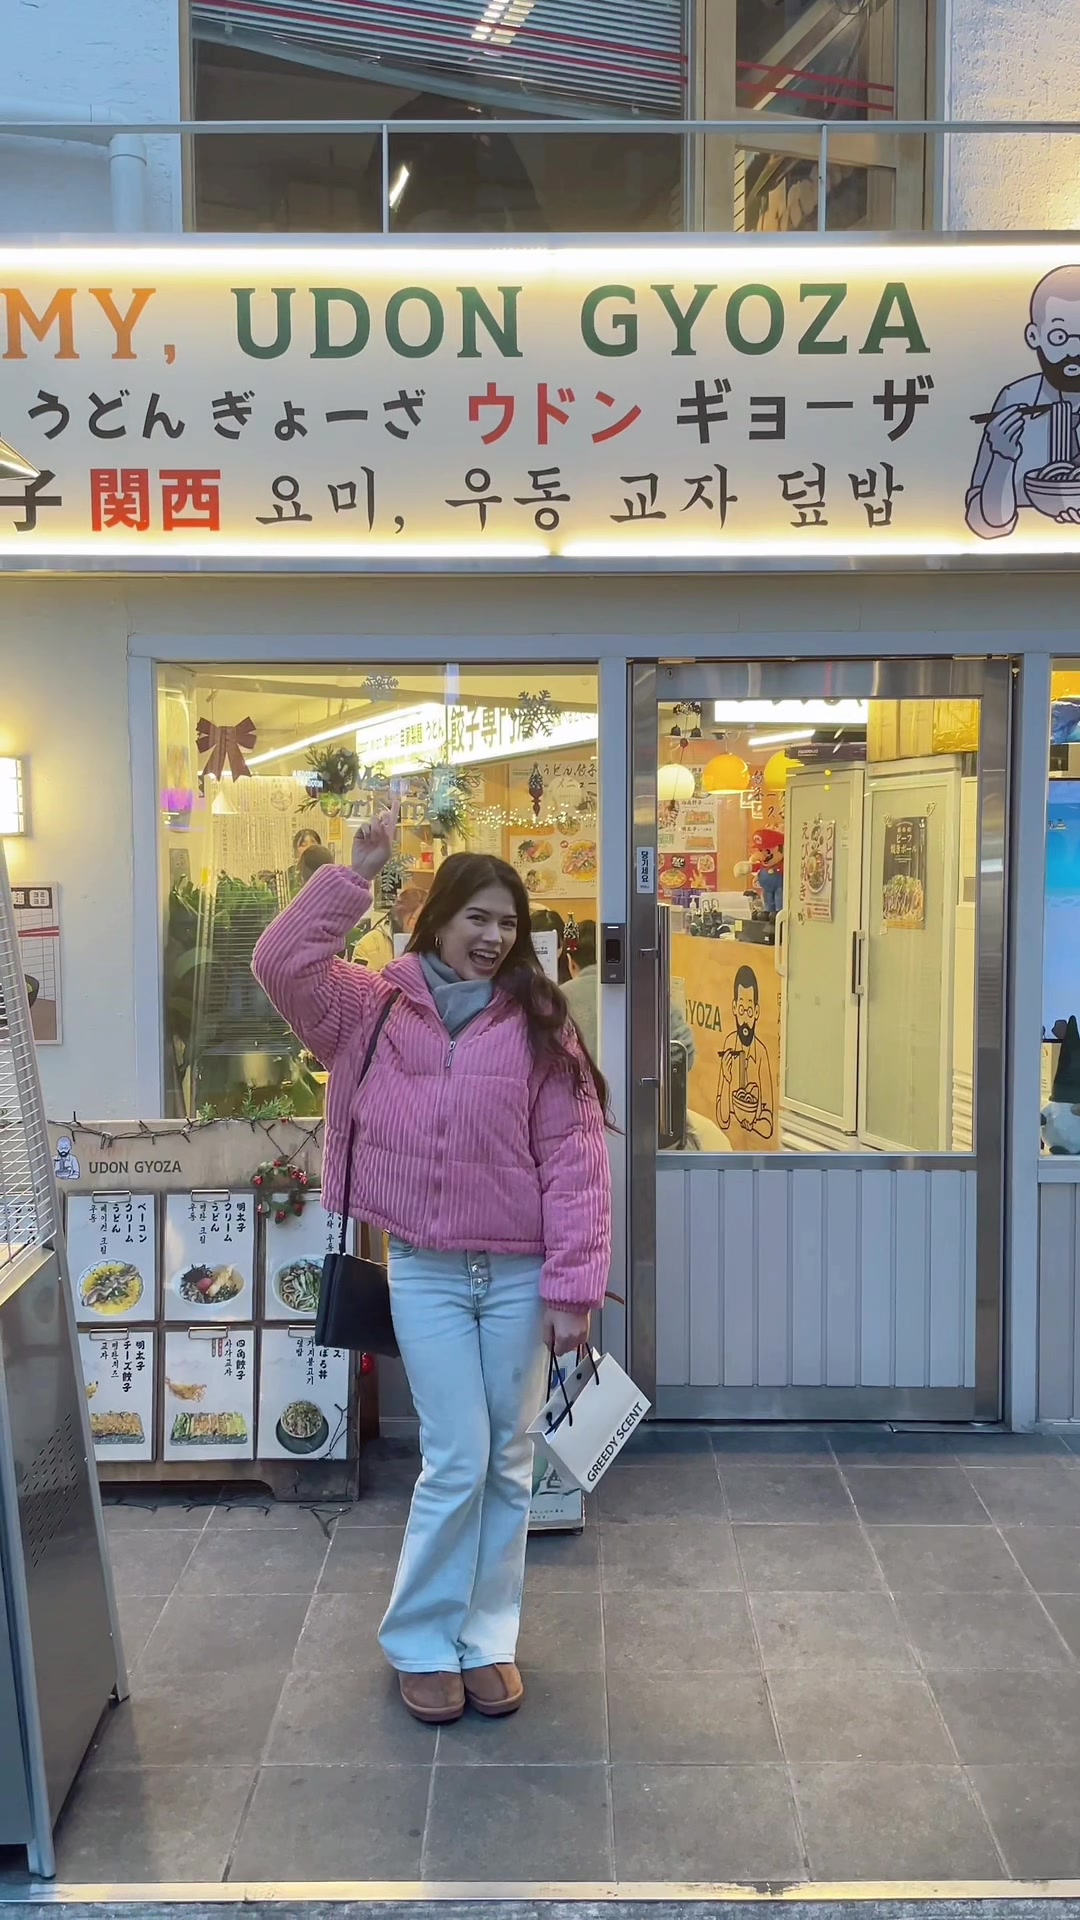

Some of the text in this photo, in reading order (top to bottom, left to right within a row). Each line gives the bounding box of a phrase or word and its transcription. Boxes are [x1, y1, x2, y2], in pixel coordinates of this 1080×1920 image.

[0, 282, 931, 365] MY, UDON GYOZA
[27, 374, 935, 446] うどん ぎょーざ ウドン ギョーザ
[90, 467, 222, 532] 関西
[255, 465, 406, 535] 요미,
[445, 467, 571, 532] 우동
[609, 463, 738, 530] 교자
[777, 461, 905, 529] 덮밥
[641, 850, 649, 883] 당기세요
[684, 999, 723, 1033] YOZA
[89, 1160, 182, 1174] UDON GYOZA
[112, 1203, 121, 1234] うどん
[125, 1203, 134, 1243] クリーム
[137, 1202, 148, 1244] ベーコン
[211, 1202, 220, 1233] うどん
[224, 1202, 233, 1243] クリーム
[236, 1202, 247, 1233] 明太子
[136, 1340, 146, 1372] 明太子
[587, 1401, 643, 1482] GREEDY SCENT
